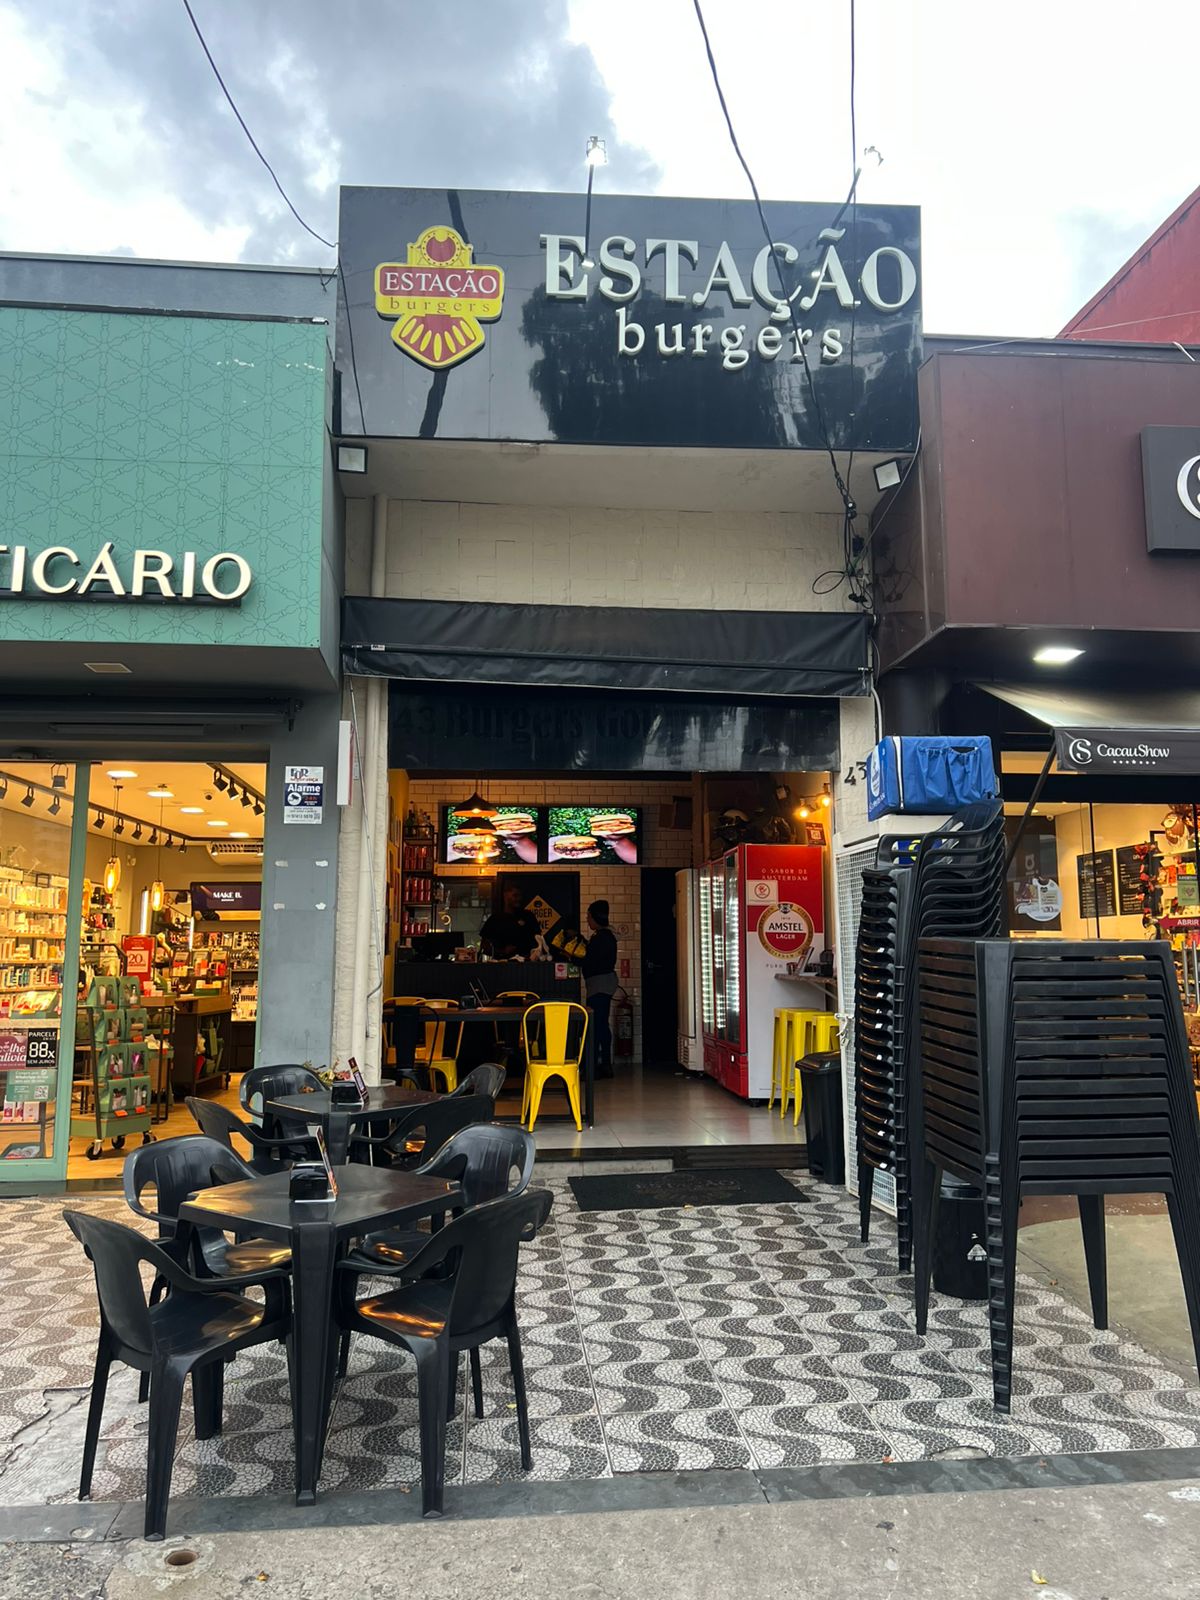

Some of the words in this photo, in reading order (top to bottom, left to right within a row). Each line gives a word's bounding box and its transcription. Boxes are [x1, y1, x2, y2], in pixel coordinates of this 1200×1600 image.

[540, 227, 917, 322] ESTAÇÃO
[384, 269, 498, 298] ESTAÇÃO
[390, 297, 491, 313] burgers
[616, 307, 844, 371] burgers
[1097, 743, 1170, 757] CacauShow
[288, 783, 321, 793] Alarme
[212, 891, 233, 899] MAKE
[768, 922, 803, 931] AMSTEL
